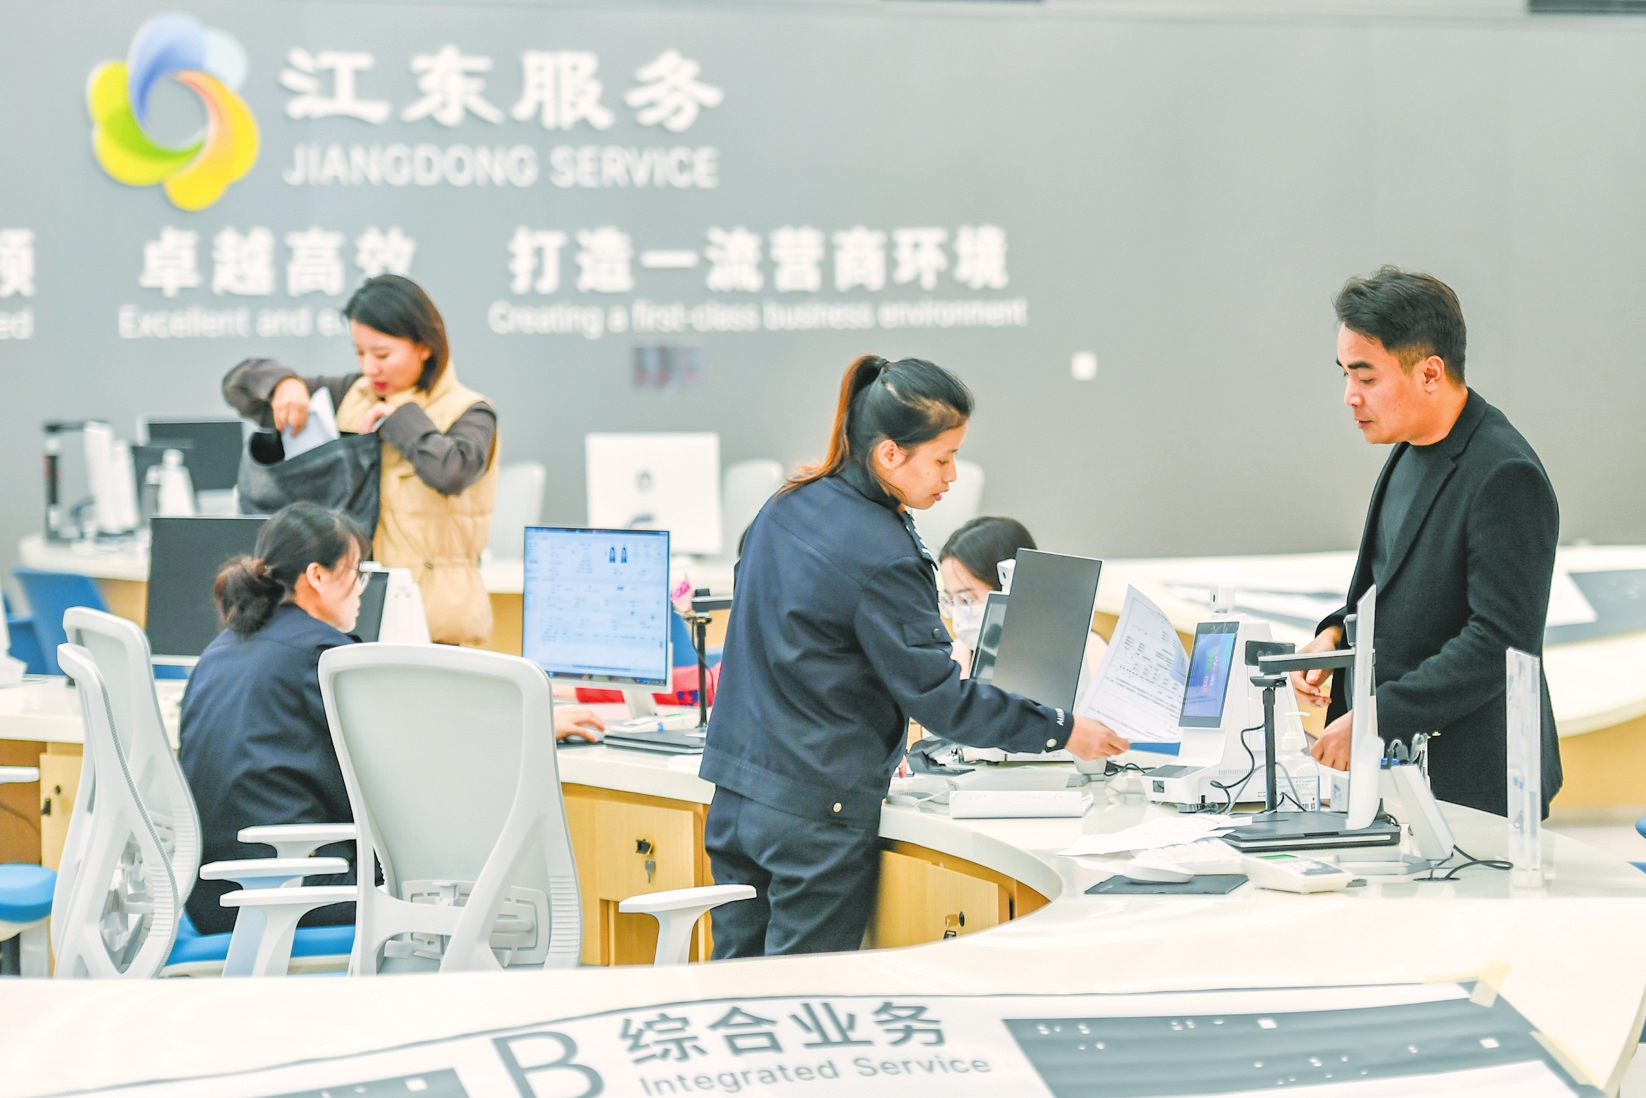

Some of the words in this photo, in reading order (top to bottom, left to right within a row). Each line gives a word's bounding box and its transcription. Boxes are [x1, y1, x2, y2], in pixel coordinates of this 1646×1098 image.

[279, 44, 724, 131] 江东服务
[283, 143, 538, 187] JIANGDONG
[550, 146, 719, 188] SERVICE
[140, 226, 416, 296] 卓越高效
[507, 225, 1009, 294] 打造一流营商环境
[118, 305, 250, 338] Excellent
[256, 306, 312, 337] and
[488, 301, 604, 339] Creating
[608, 306, 628, 333] a
[632, 300, 760, 332] first-class
[763, 301, 875, 331] business
[877, 299, 1027, 328] environment
[491, 1031, 604, 1098] B
[619, 1000, 946, 1066] 综合业务
[638, 1059, 841, 1097] Integrated
[852, 1055, 992, 1078] Service
